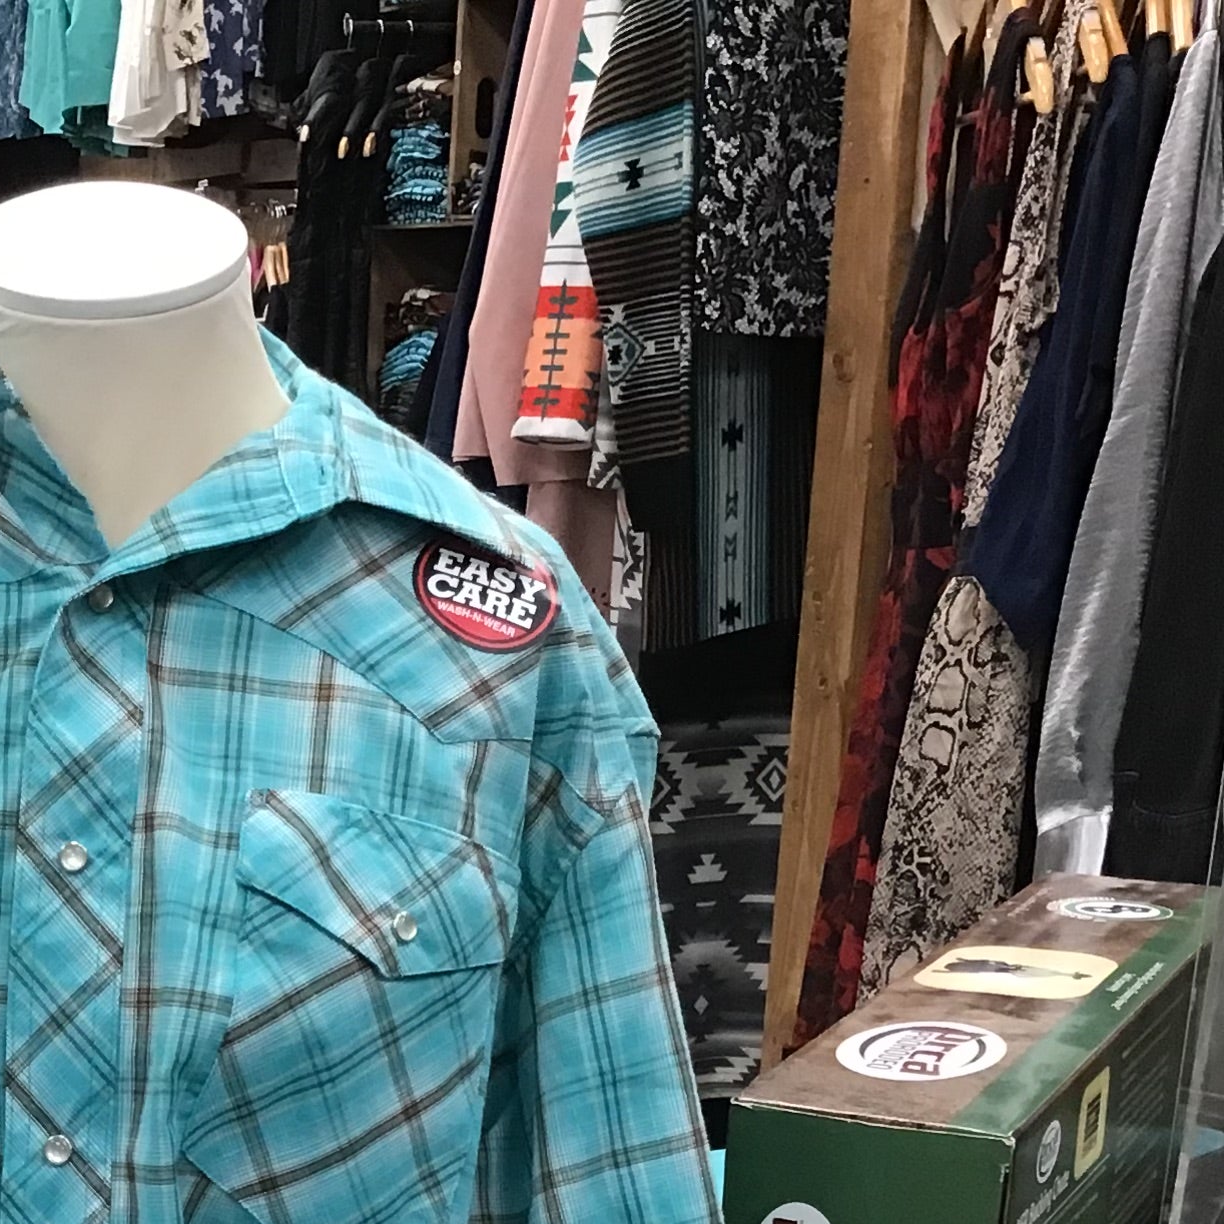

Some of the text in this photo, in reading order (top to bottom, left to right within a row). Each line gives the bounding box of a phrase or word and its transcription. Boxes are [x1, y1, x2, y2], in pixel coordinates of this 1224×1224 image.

[427, 573, 538, 630] CARE
[433, 548, 547, 604] EASY
[436, 600, 517, 638] WASH-N-WEAR
[899, 1026, 988, 1076] prca
